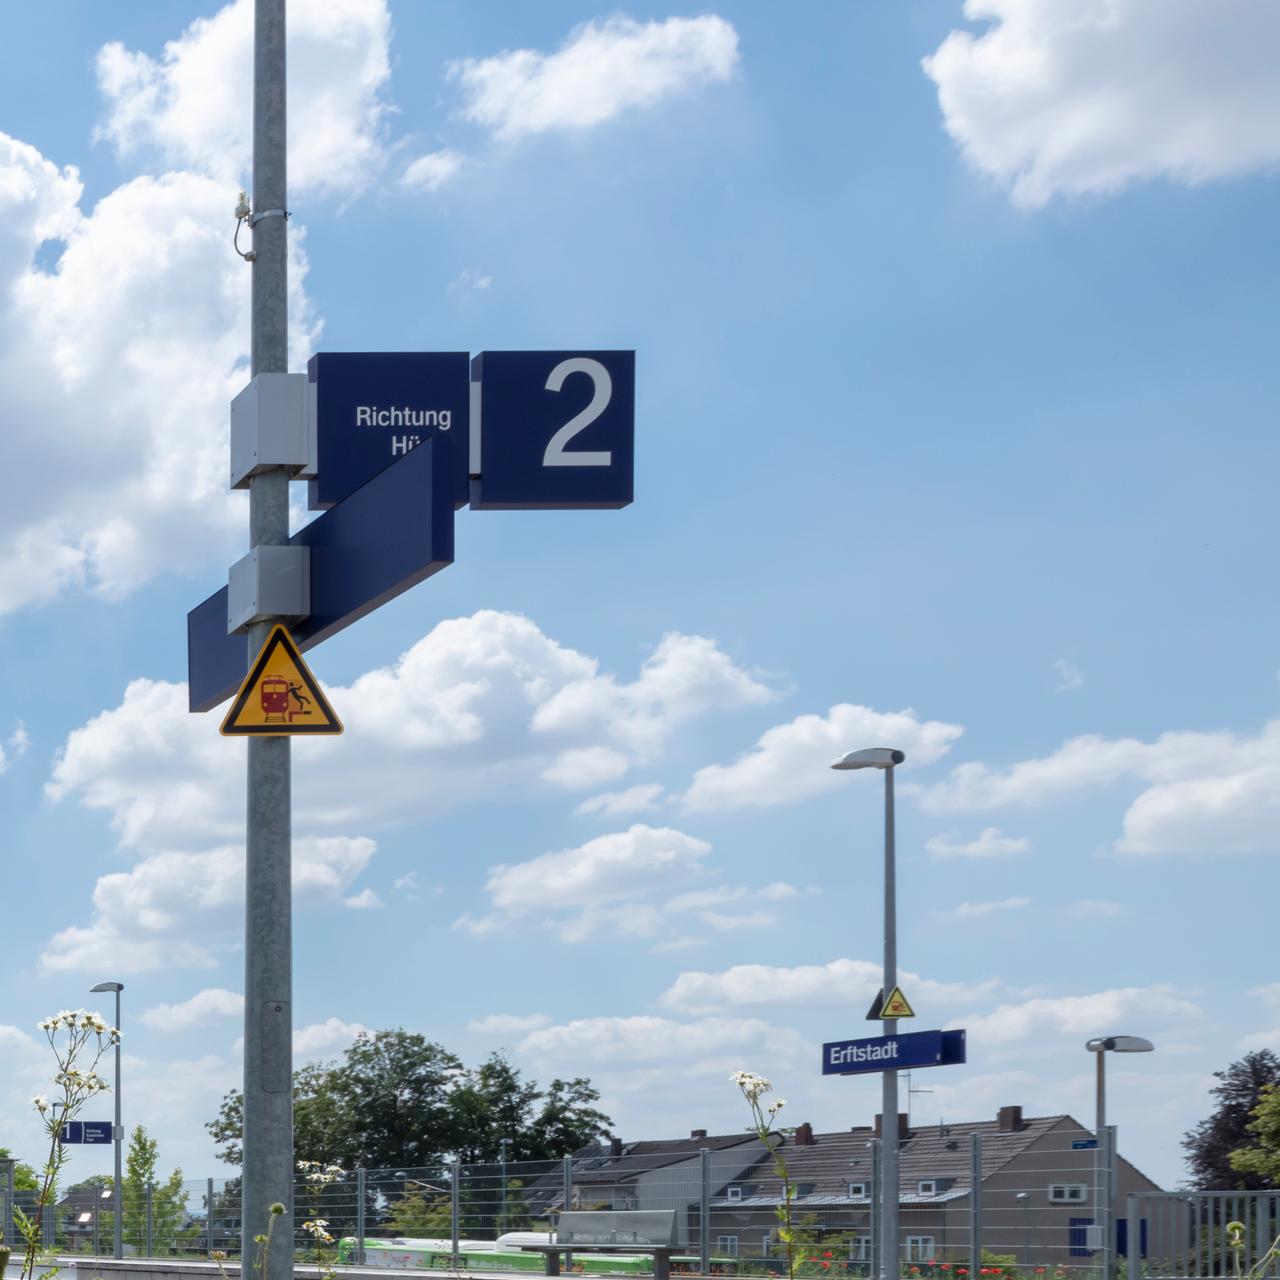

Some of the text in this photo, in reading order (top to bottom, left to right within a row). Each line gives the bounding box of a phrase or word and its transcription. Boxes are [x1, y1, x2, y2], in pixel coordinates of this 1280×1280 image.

[356, 406, 452, 431] Richtung
[542, 357, 612, 467] 2
[830, 1040, 898, 1065] Erftstadt
[62, 1122, 71, 1139] 1
